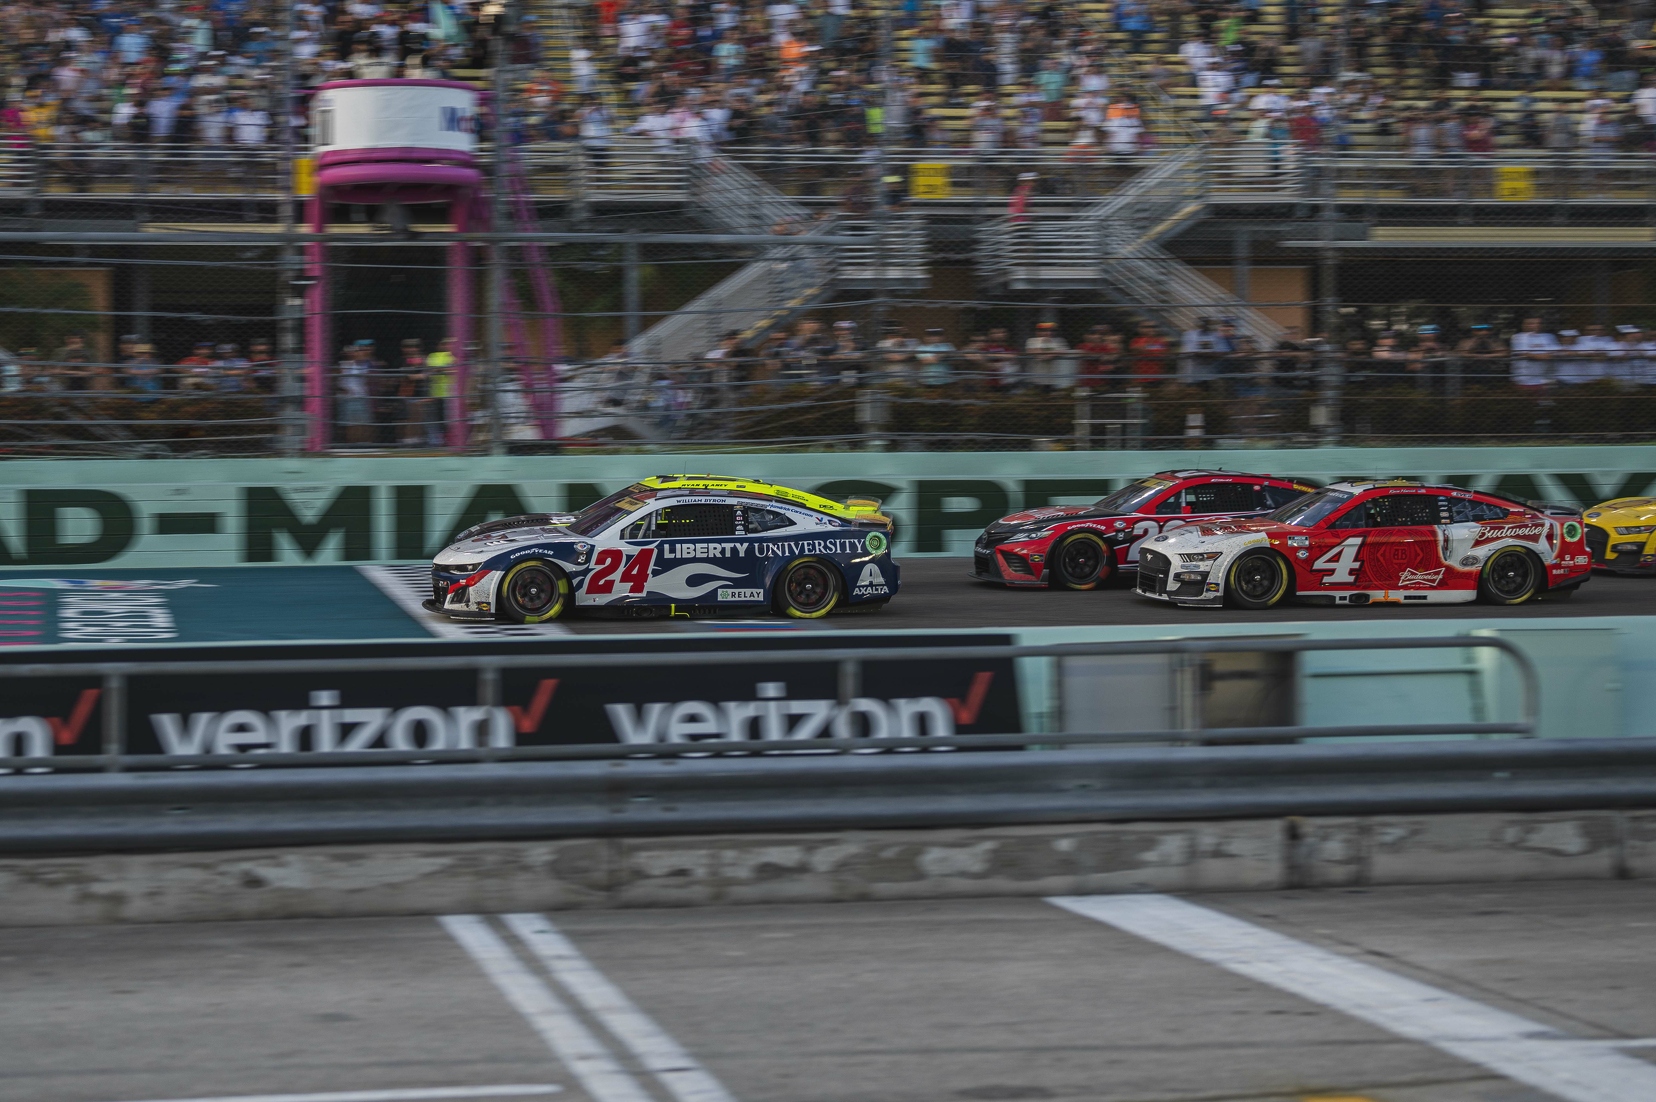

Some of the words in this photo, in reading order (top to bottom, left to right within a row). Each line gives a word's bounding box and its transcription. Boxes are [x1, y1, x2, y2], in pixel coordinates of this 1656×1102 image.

[1067, 522, 1106, 531] GOODYEAR
[1474, 522, 1550, 541] Budweiser
[510, 547, 554, 559] GOODYEAR
[664, 542, 749, 559] LIBERTY
[754, 538, 865, 557] UNIVERSITY
[1311, 536, 1364, 583] 4
[585, 548, 656, 595] 24
[1398, 571, 1444, 581] Budweiser
[730, 591, 762, 599] RELAY
[853, 585, 889, 595] AXALTA
[150, 689, 517, 768] verizon
[604, 681, 957, 758] verizon
